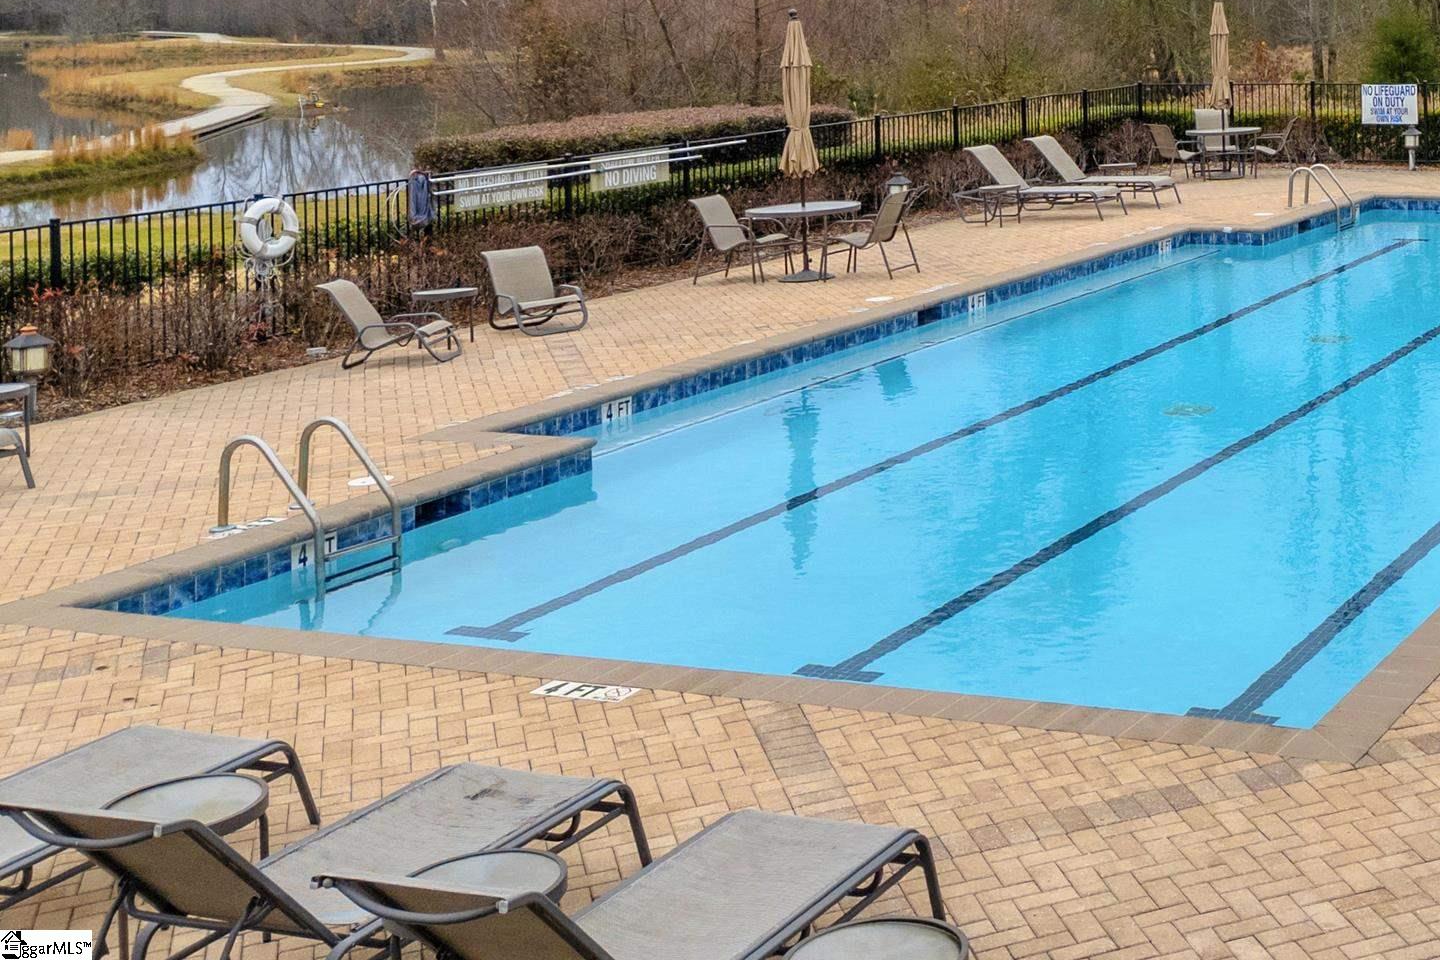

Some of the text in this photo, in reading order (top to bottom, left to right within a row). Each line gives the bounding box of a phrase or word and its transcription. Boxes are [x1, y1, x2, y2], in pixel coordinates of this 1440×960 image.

[1363, 86, 1416, 96] NO LIFEGUARD
[1373, 97, 1405, 107] ON DUTY
[604, 166, 656, 187] NO DIVING
[460, 185, 544, 208] SWIM AT YOUR OWN RISK
[606, 400, 630, 421] 4 FT
[298, 543, 308, 566] 4
[543, 683, 607, 697] 4 FT
